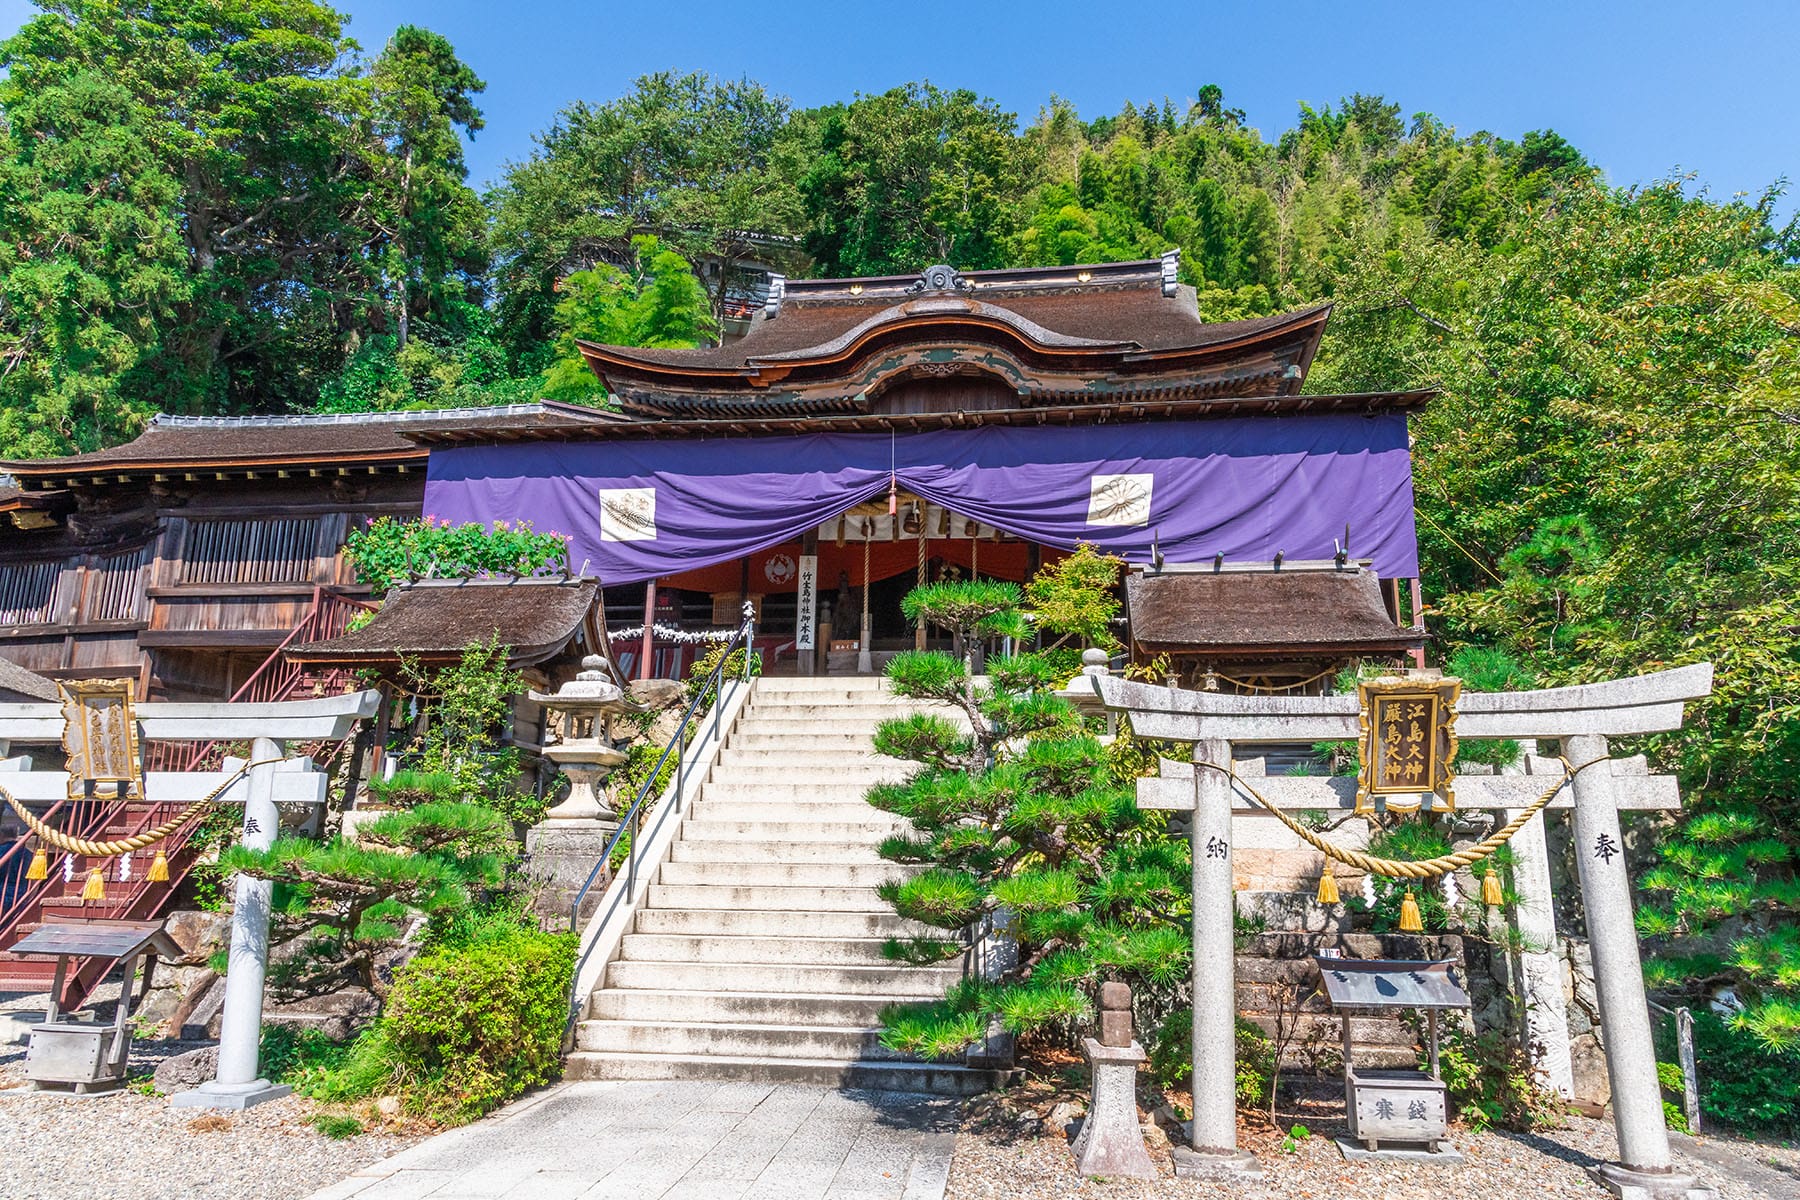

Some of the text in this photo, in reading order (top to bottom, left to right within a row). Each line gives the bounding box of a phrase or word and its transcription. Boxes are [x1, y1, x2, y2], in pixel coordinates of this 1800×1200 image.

[1404, 703, 1426, 784] 江島大神
[243, 816, 262, 837] 奉
[1205, 835, 1229, 861] 納
[1593, 832, 1620, 865] 奉
